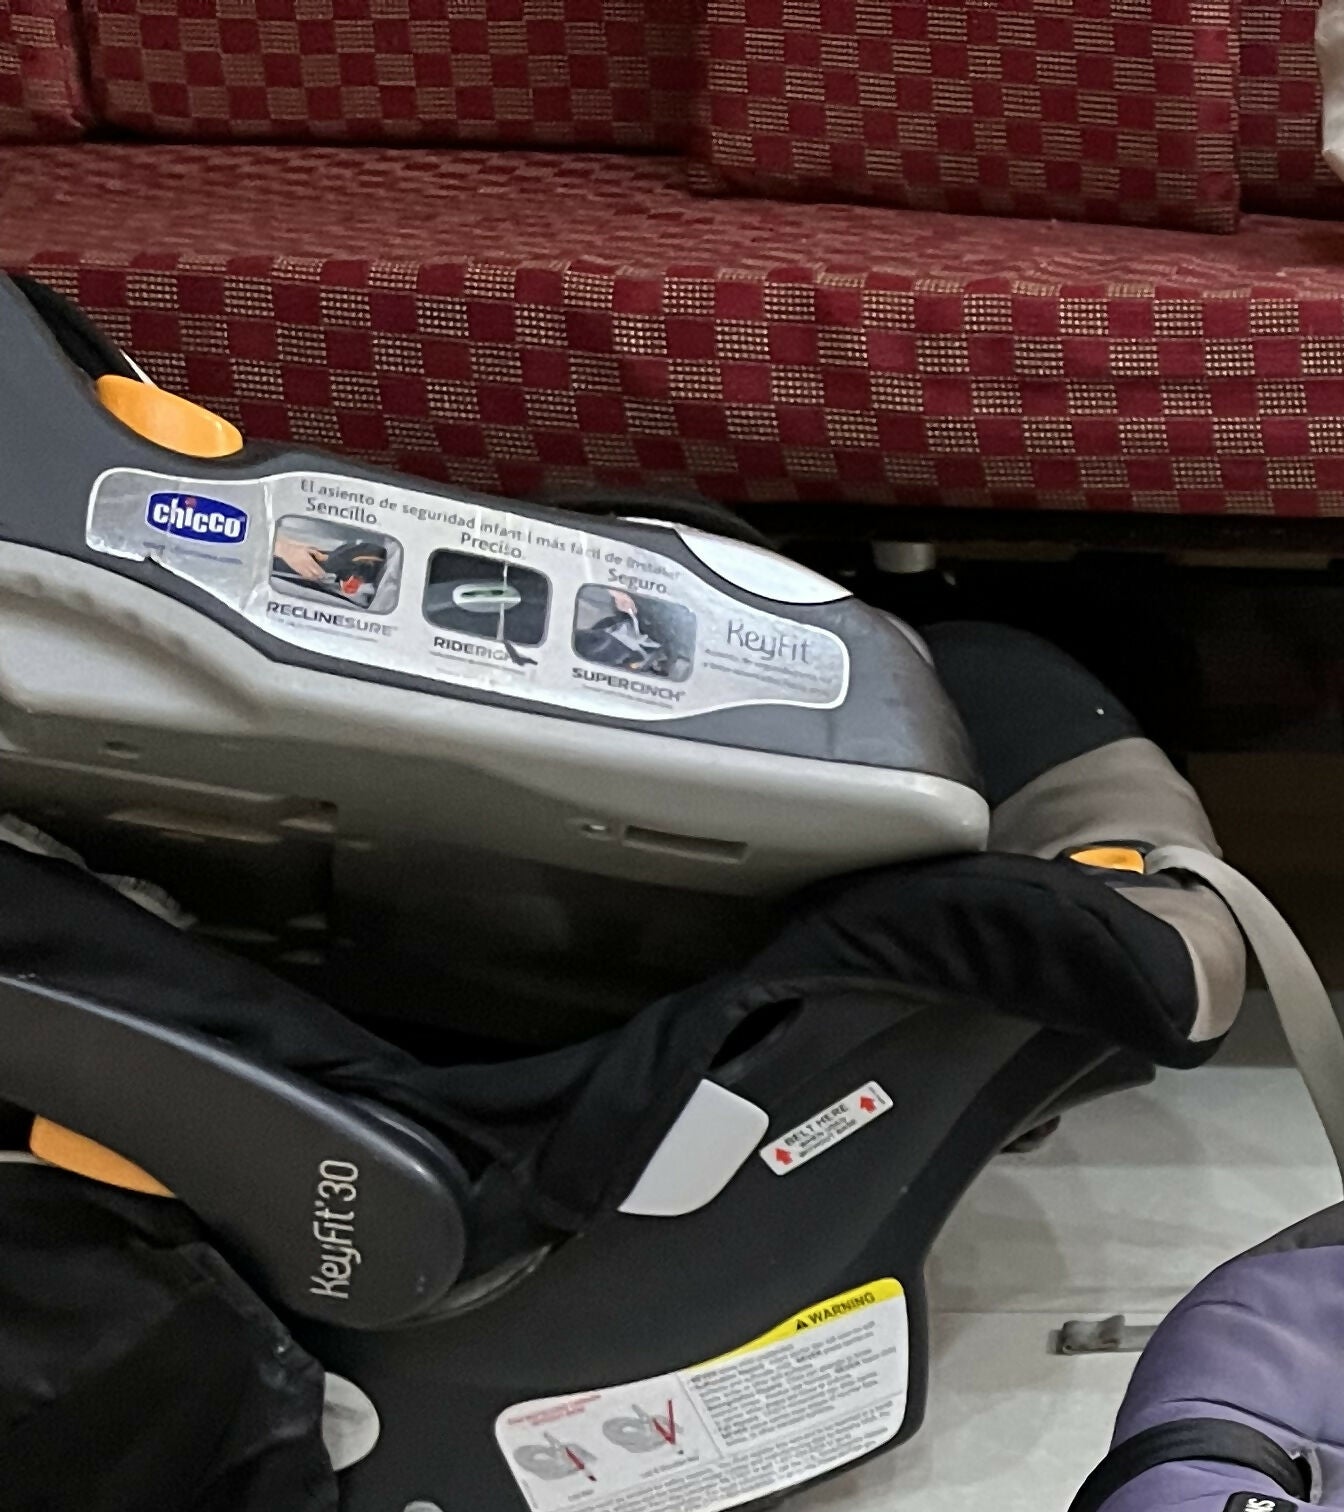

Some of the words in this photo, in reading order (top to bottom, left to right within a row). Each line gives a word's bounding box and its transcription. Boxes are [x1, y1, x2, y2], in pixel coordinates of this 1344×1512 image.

[153, 496, 241, 538] chicco
[305, 497, 377, 525] Sencillo
[321, 483, 375, 506] asiento
[379, 498, 397, 511] de
[402, 503, 475, 529] seguridad
[461, 531, 523, 559] Preciso
[608, 567, 668, 595] Seguro
[726, 618, 810, 664] KeyFit
[784, 1123, 815, 1147] BELT
[318, 1160, 359, 1202] 30
[309, 1208, 362, 1299] KeyFit
[808, 1291, 876, 1324] WARNING
